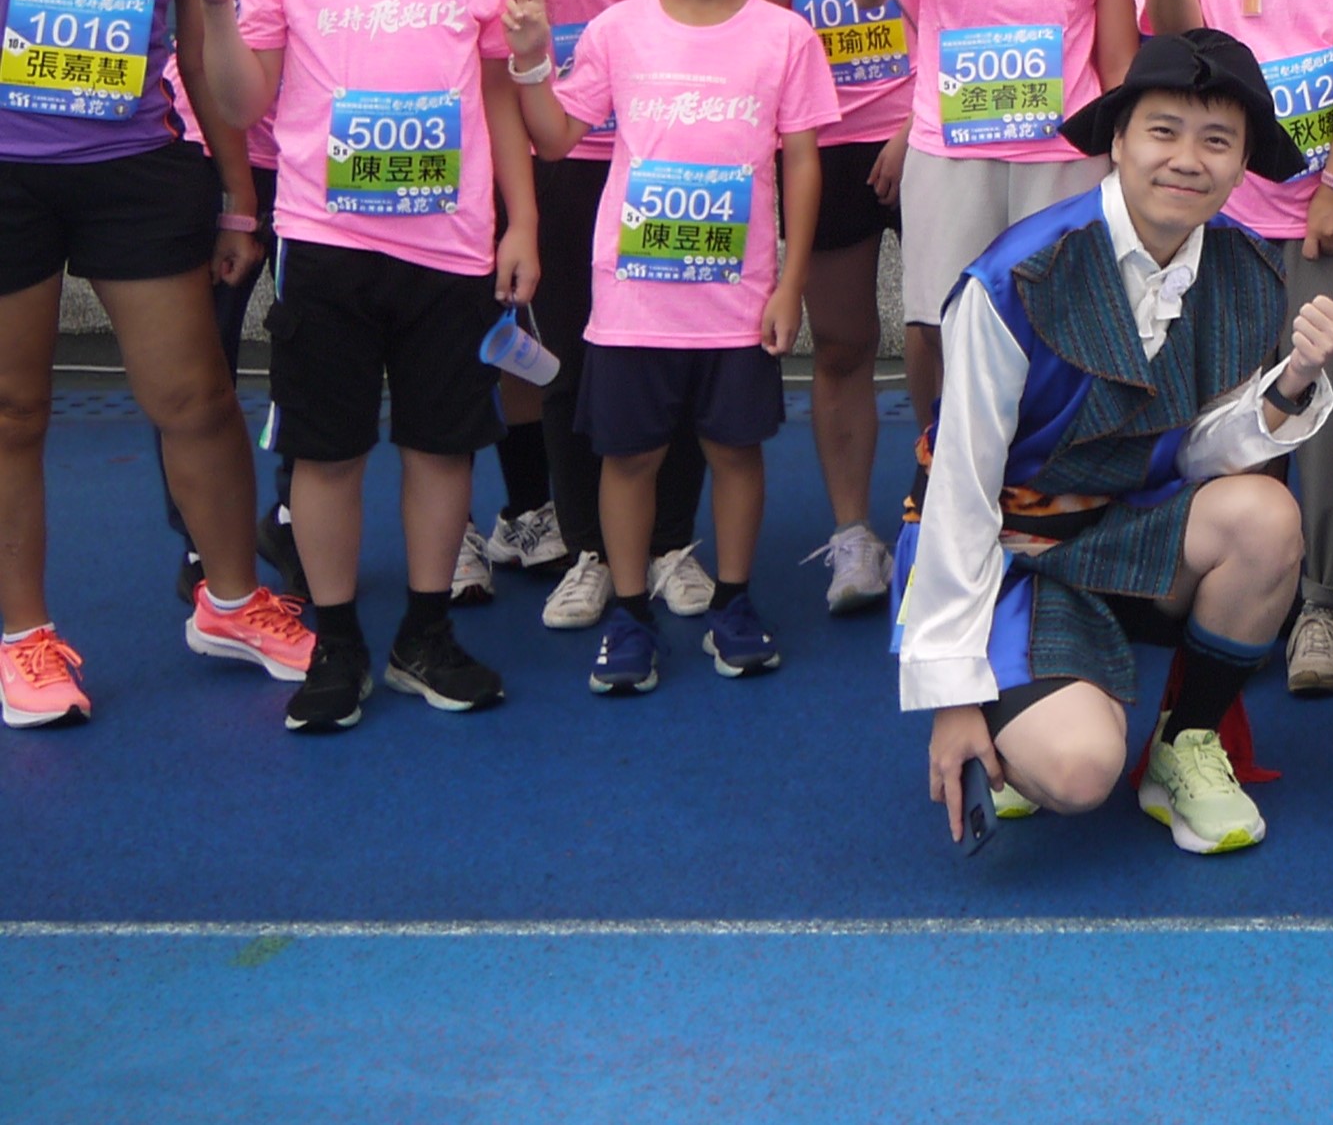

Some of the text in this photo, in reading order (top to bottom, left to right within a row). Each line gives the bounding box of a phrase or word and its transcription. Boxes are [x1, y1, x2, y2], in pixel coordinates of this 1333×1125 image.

[29, 10, 132, 53] 1016
[26, 48, 129, 87] 張嘉慧
[954, 47, 1047, 84] 5006
[961, 82, 1049, 114] 塗睿潔
[346, 116, 447, 151] 5003
[350, 154, 447, 183] 陳昱霖
[639, 184, 735, 222] 5004
